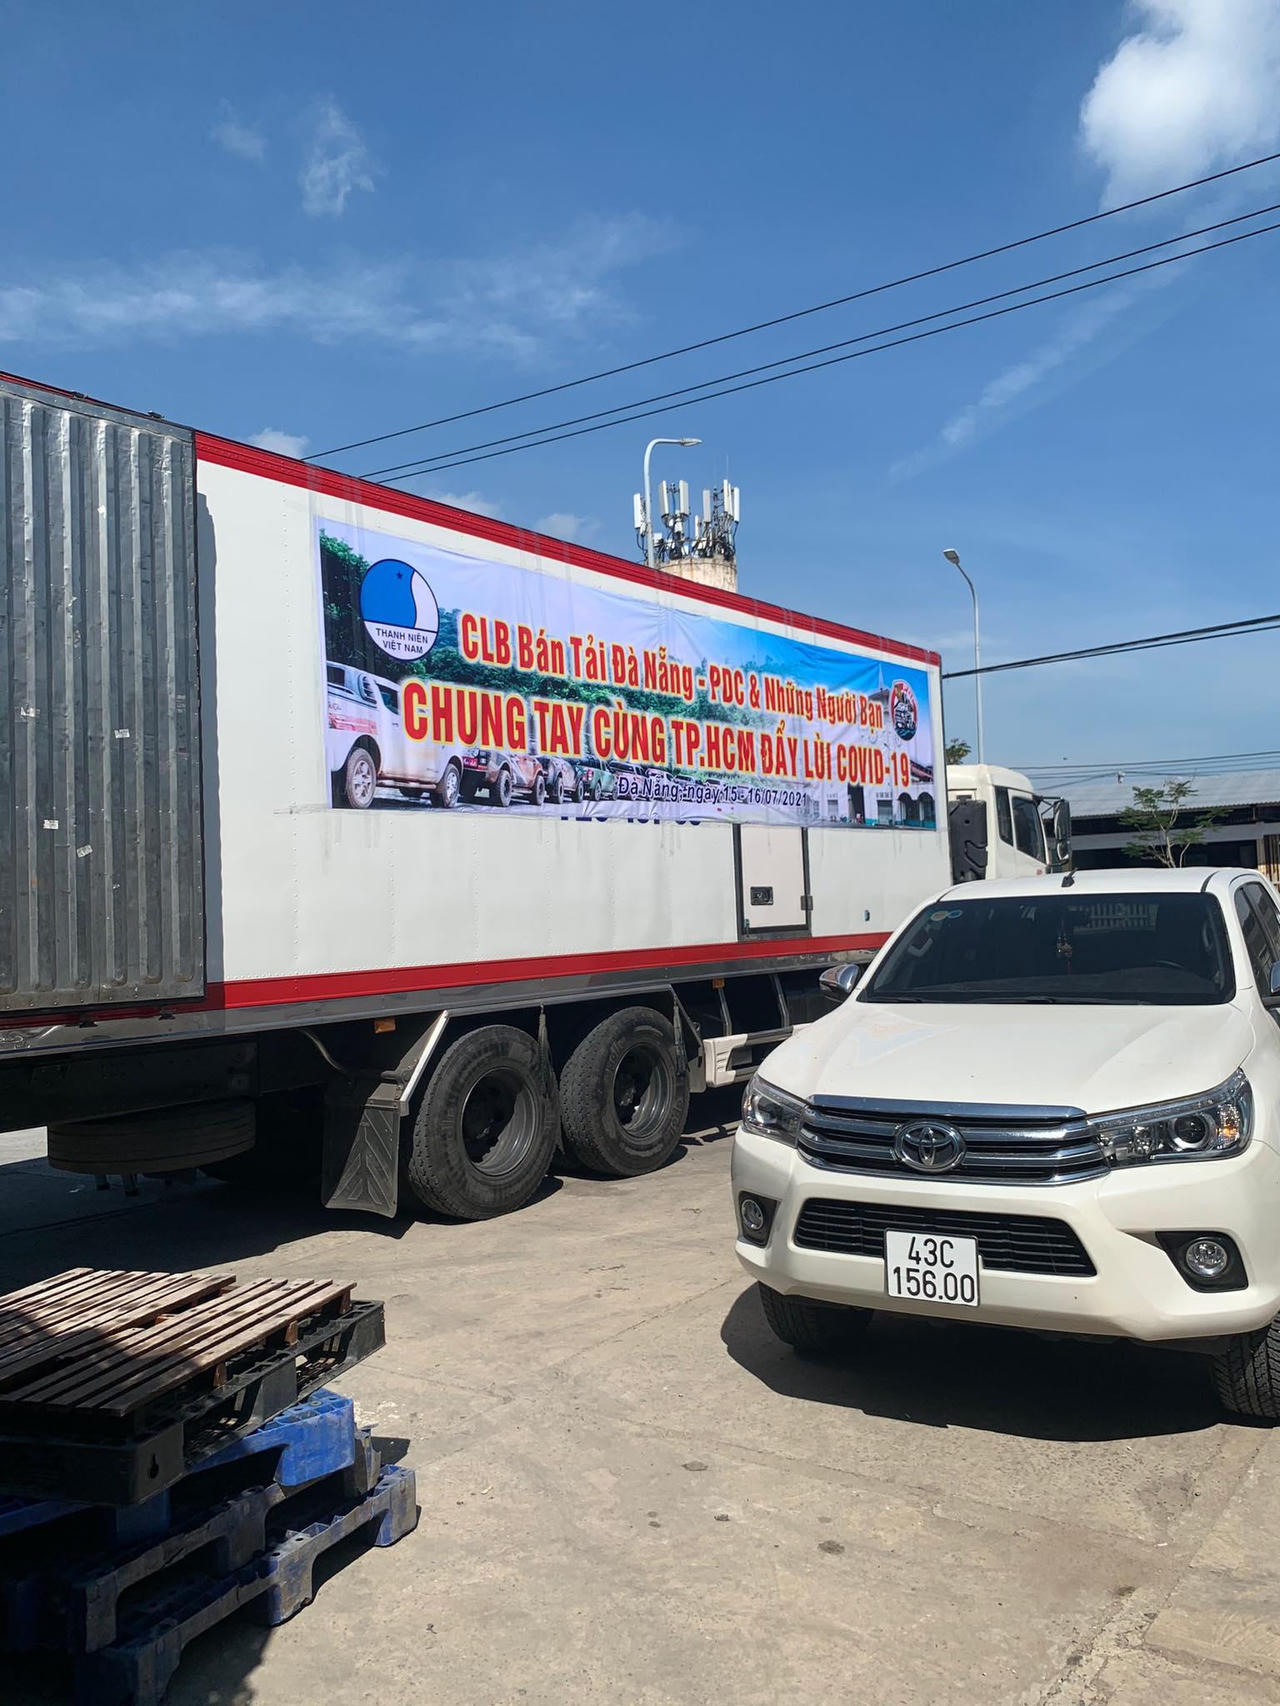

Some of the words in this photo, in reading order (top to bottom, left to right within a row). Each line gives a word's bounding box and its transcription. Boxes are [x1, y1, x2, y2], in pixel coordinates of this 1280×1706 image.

[376, 627, 406, 640] THANH
[408, 632, 428, 643] NIÊN
[404, 644, 424, 653] NAM
[462, 614, 510, 665] CLB
[518, 626, 565, 675] Bán
[570, 634, 605, 682] Tải
[612, 644, 639, 687] Đà
[644, 646, 692, 701] Nẵng
[698, 678, 706, 687] -
[709, 665, 744, 706] PDC
[750, 674, 760, 708] &
[765, 678, 813, 721] Những
[816, 687, 857, 724] Người
[860, 695, 883, 735] Bạn
[404, 682, 524, 750] CHUNG
[534, 701, 584, 754] TAY
[594, 700, 664, 764] CÙNG
[672, 720, 756, 772] TP.HCM
[760, 720, 797, 777] ĐẨY
[804, 732, 832, 781] LÙI
[837, 743, 910, 788] COVID-19
[618, 777, 639, 795] Đà
[687, 783, 720, 804] ngày
[723, 786, 737, 802] 15
[748, 789, 806, 807] 16/07/2021
[908, 1236, 954, 1268] 43C
[893, 1266, 975, 1303] 156.00
